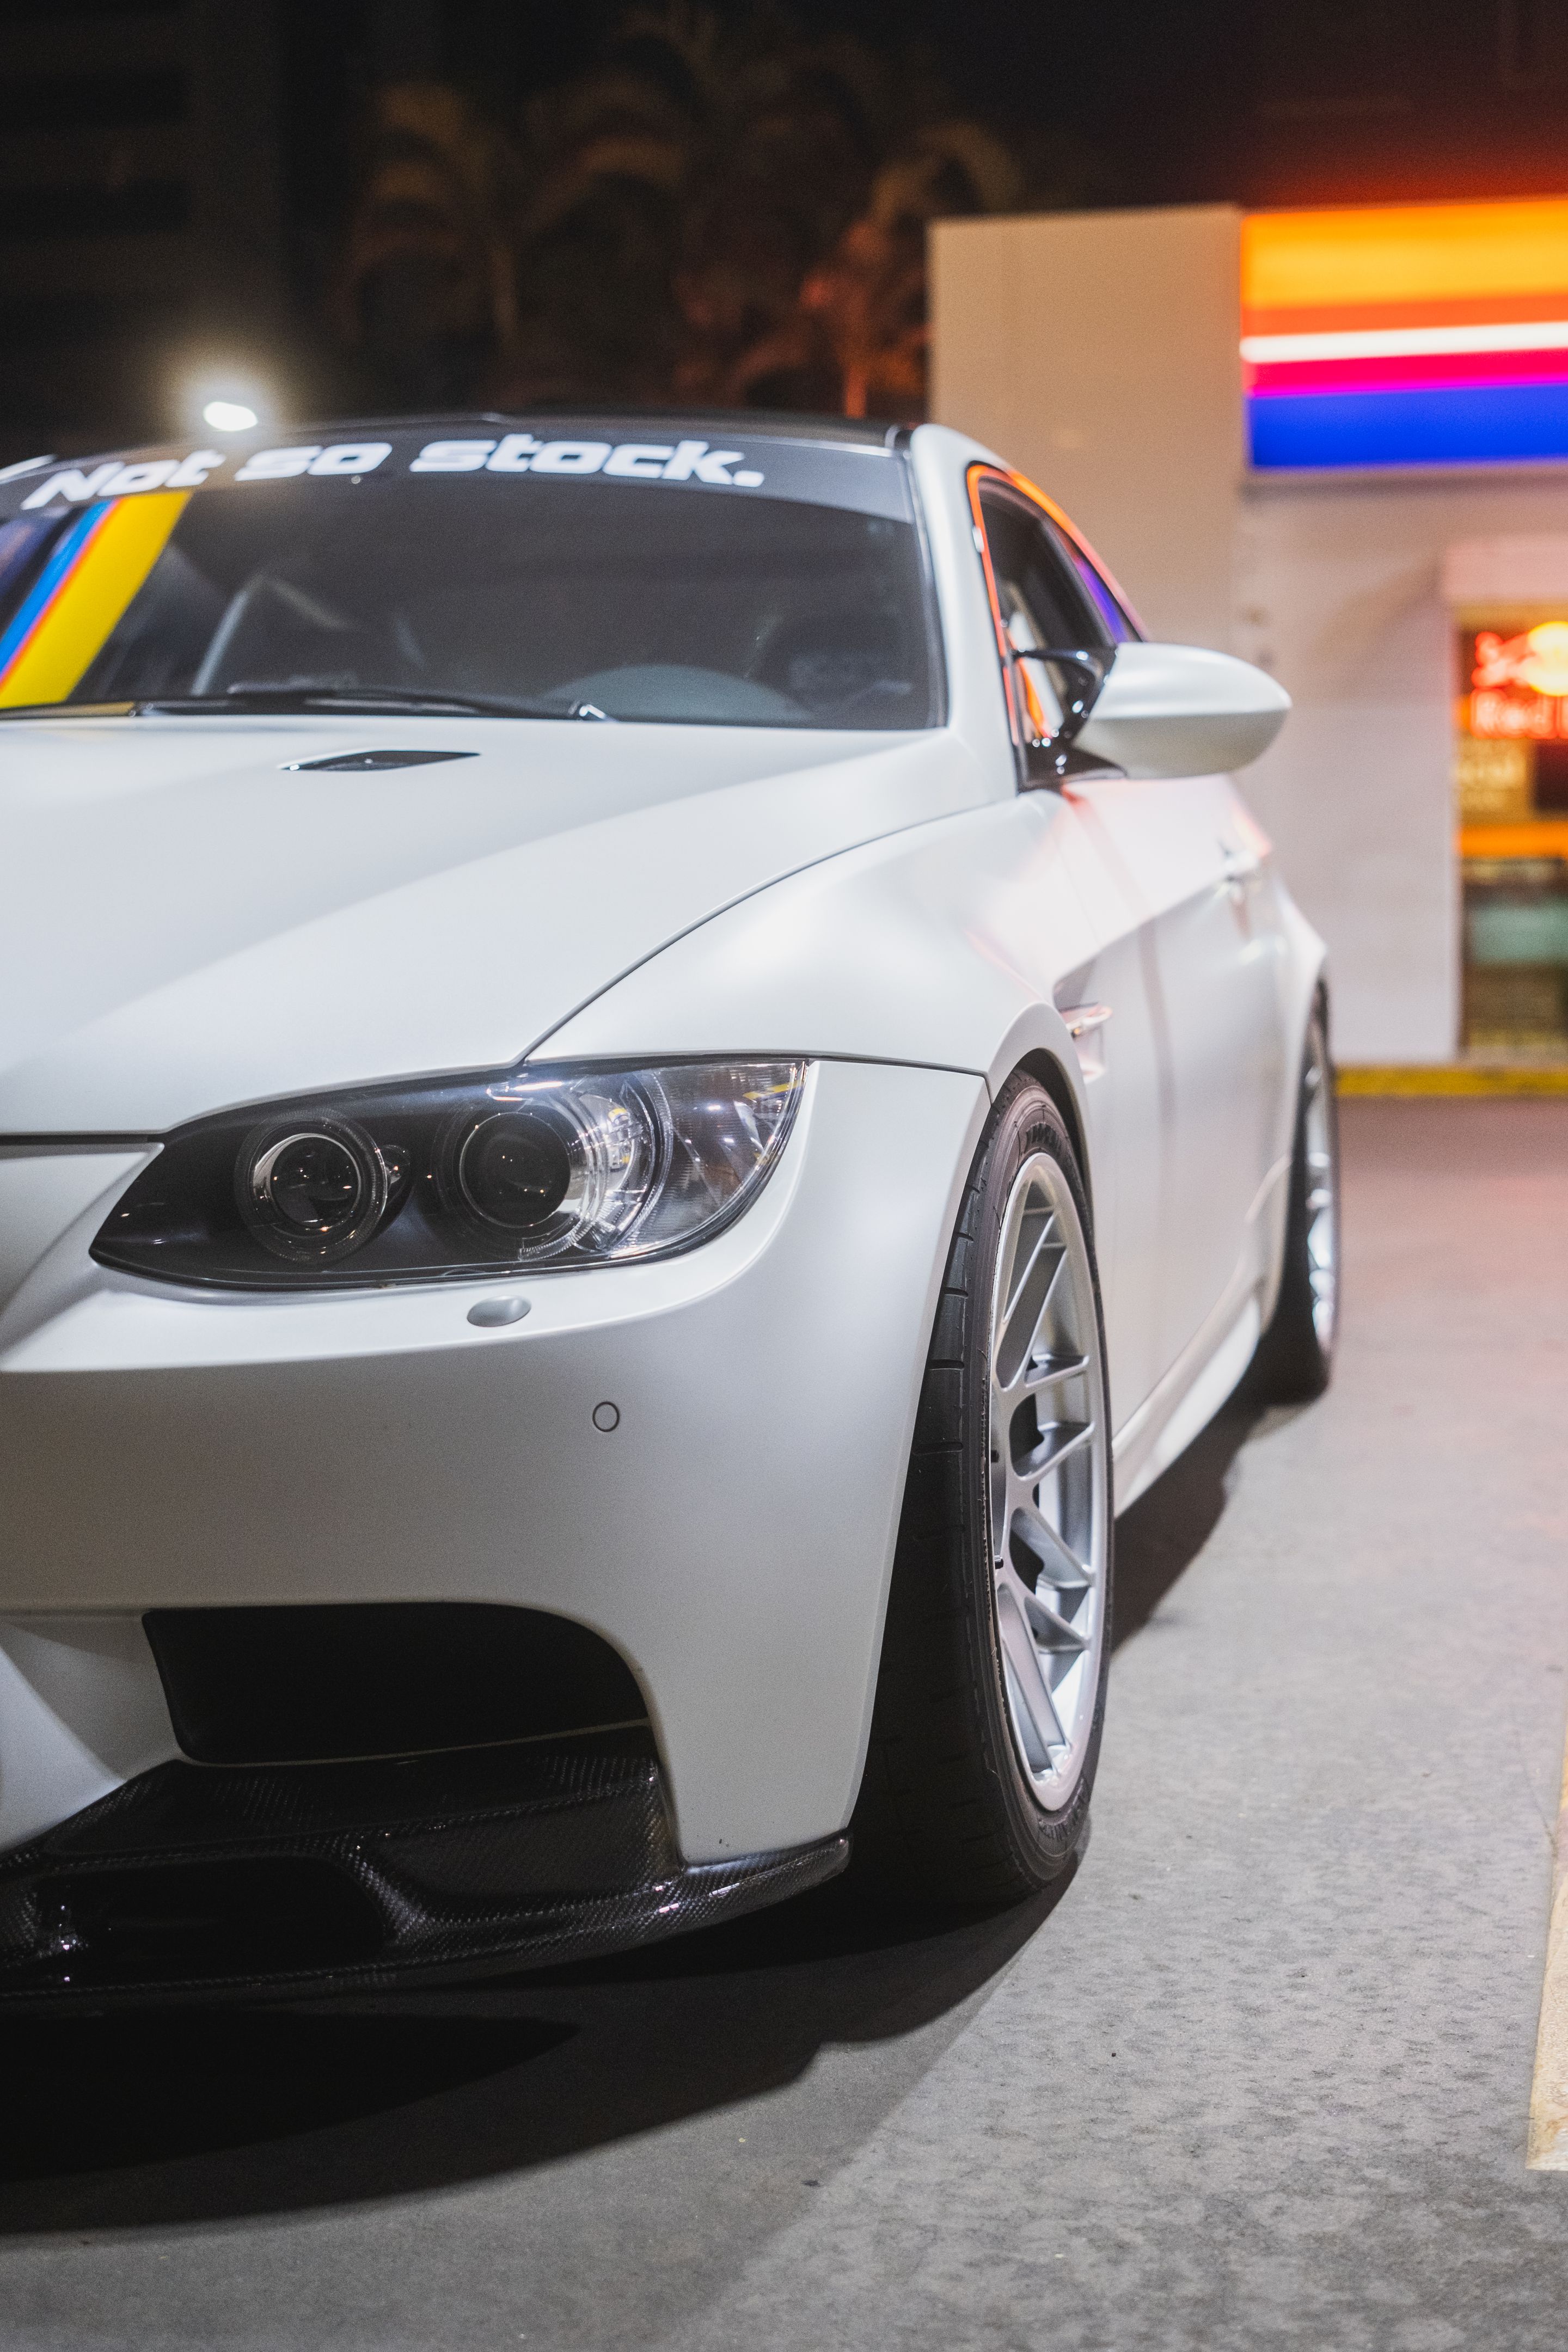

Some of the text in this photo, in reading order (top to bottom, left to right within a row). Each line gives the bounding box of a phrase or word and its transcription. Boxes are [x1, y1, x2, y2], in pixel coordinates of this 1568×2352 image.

[21, 433, 764, 510] Not so stock.
